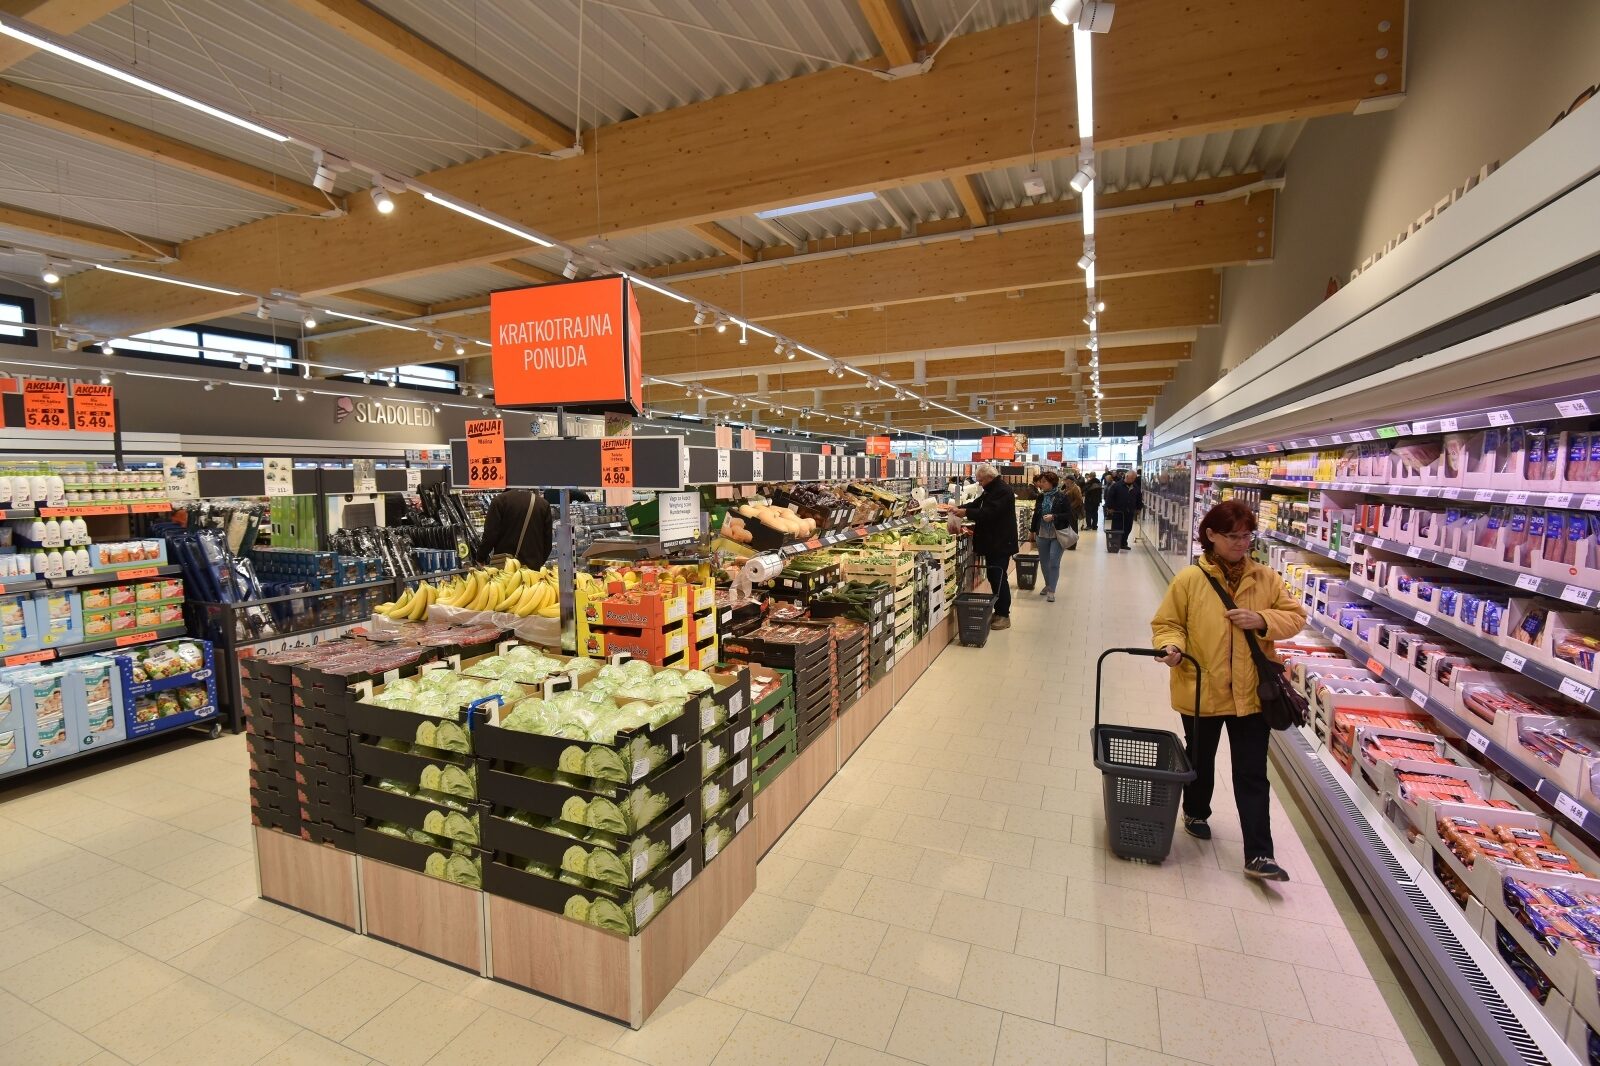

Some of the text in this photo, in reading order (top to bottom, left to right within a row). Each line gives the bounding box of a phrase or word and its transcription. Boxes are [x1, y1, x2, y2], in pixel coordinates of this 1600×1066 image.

[499, 313, 613, 346] KRATKOTRAJNA
[524, 344, 588, 371] PONUDA
[25, 382, 66, 393] AKCIJA!
[75, 386, 112, 397] AKCIJA!
[28, 413, 60, 426] 5.49
[77, 415, 106, 428] 5.49
[356, 402, 435, 427] SLADOLEDI
[467, 420, 502, 435] AKCIJA!
[471, 466, 498, 481] 8.88
[604, 472, 625, 484] 4.99
